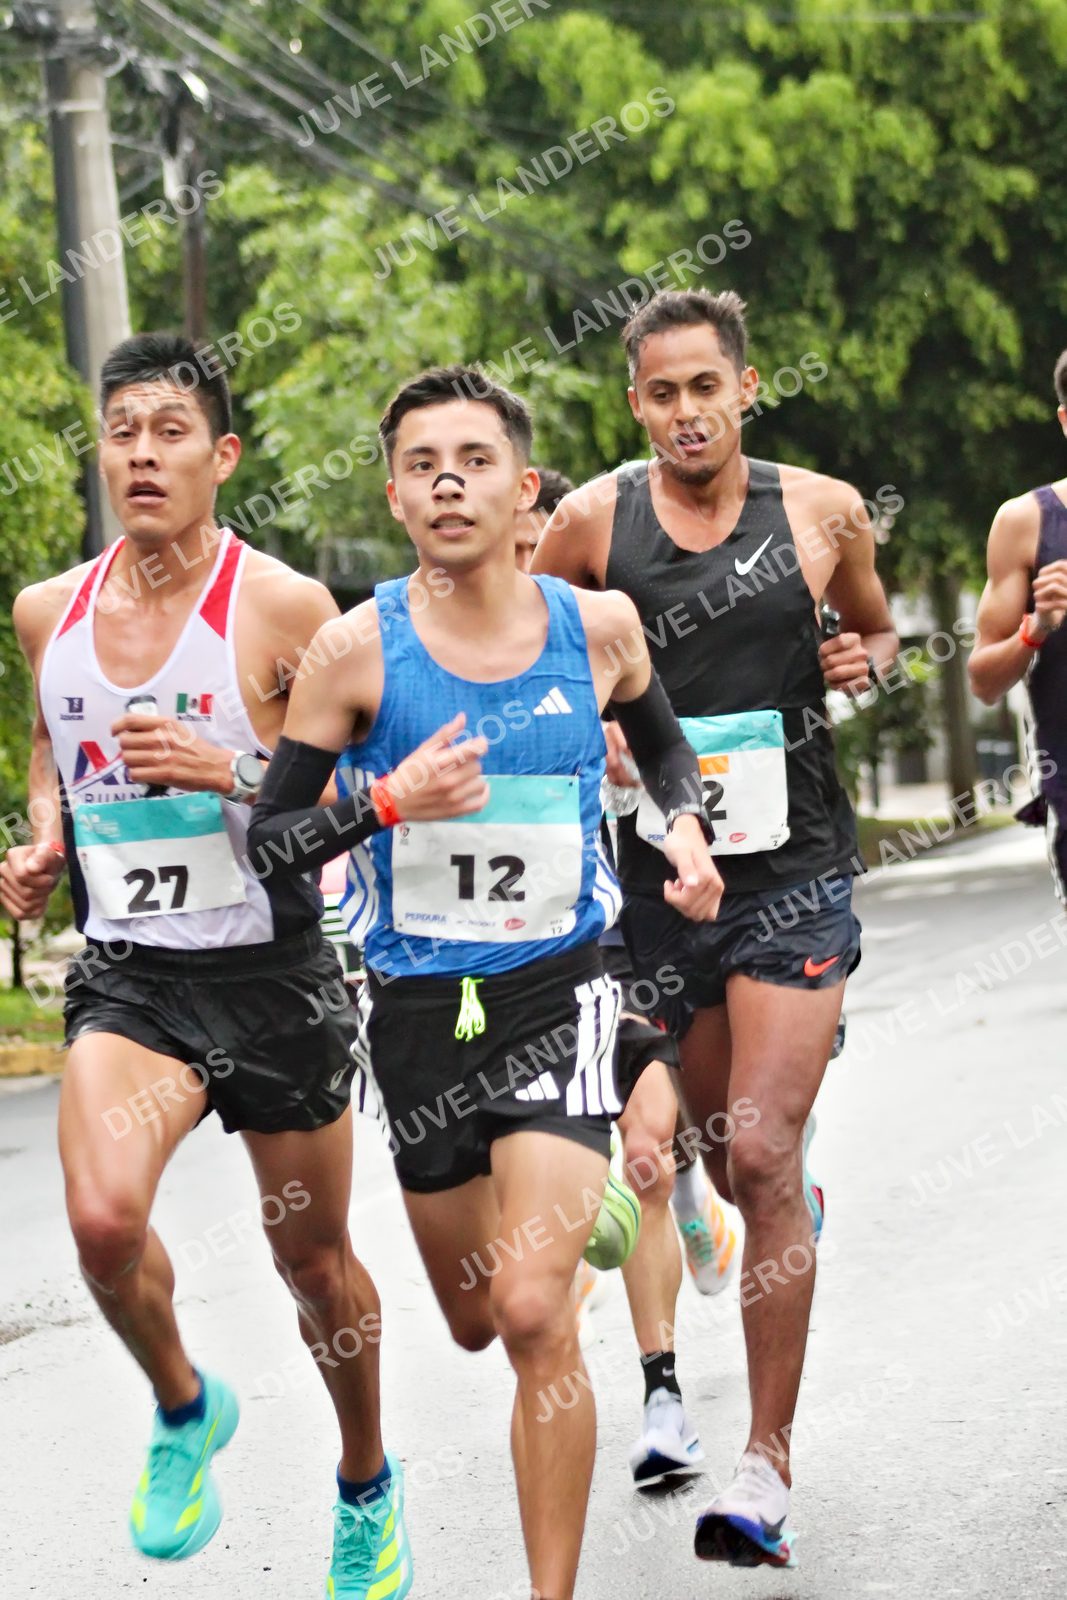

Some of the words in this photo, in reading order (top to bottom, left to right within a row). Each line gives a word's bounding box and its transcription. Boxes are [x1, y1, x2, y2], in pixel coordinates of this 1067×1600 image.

[701, 780, 727, 822] 2
[123, 865, 188, 914] 27
[450, 854, 526, 902] 12
